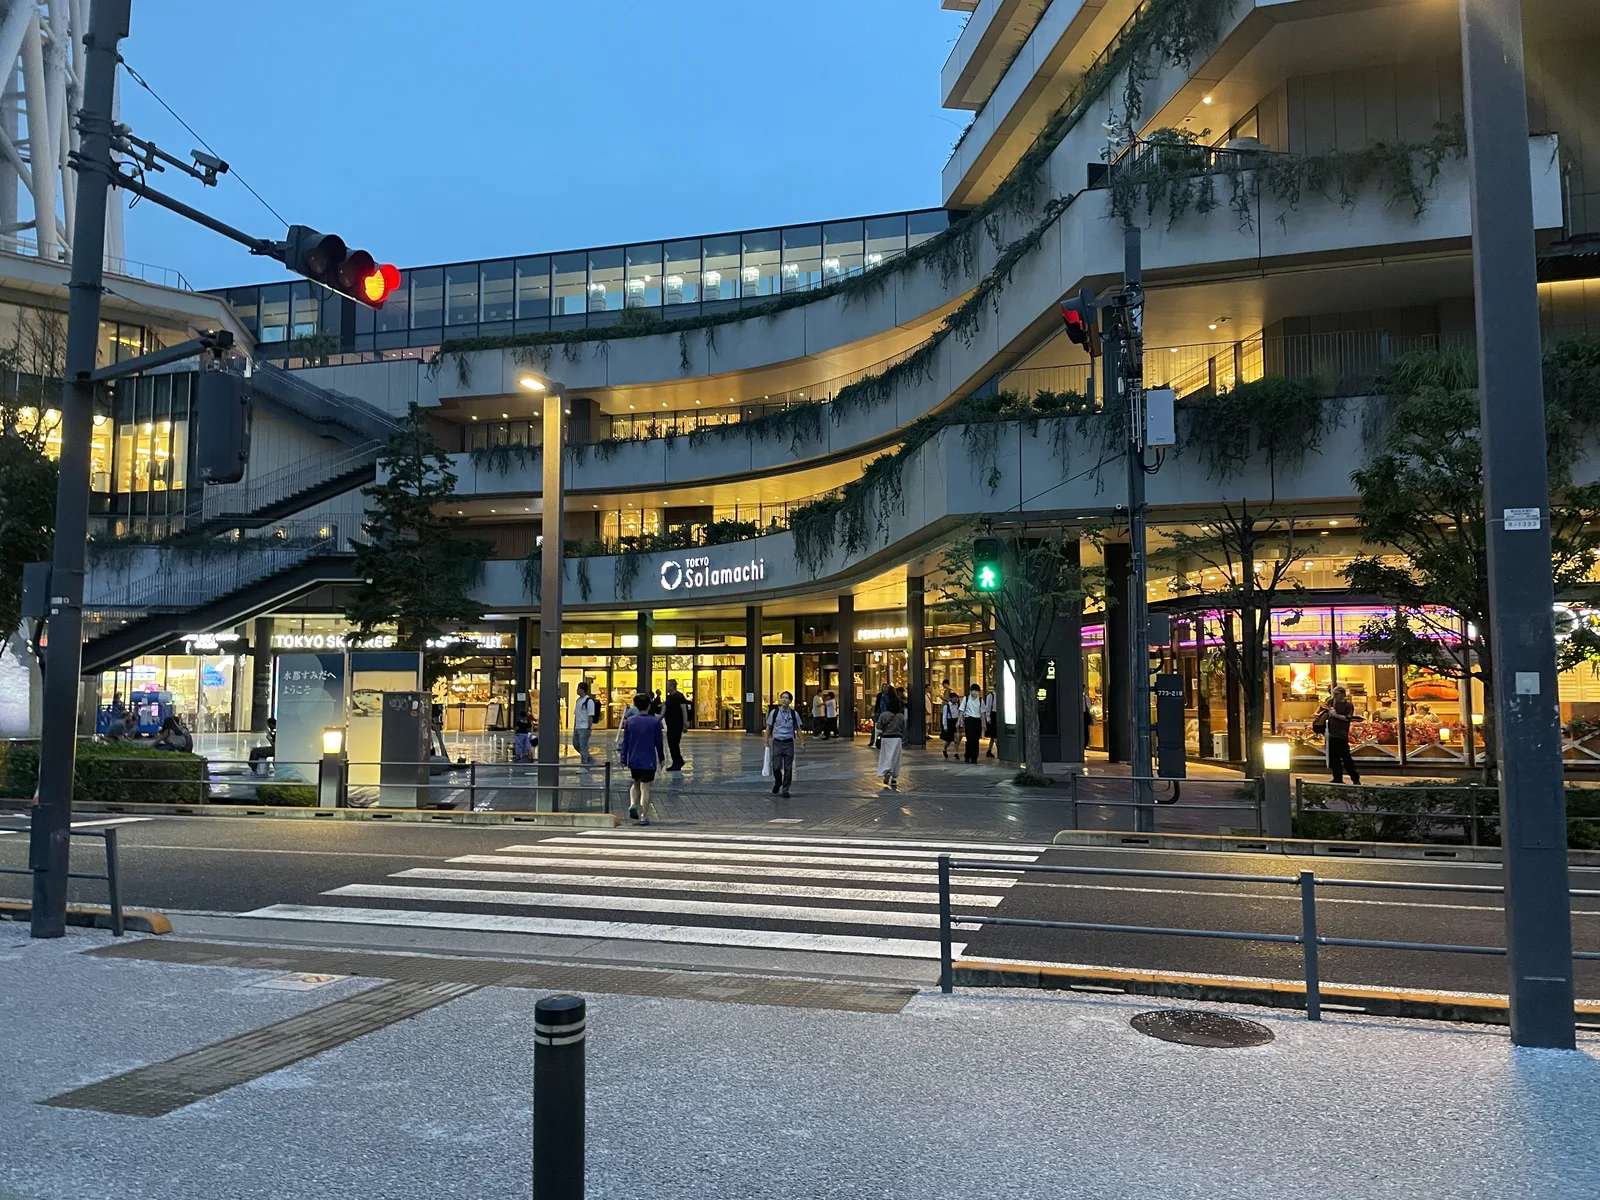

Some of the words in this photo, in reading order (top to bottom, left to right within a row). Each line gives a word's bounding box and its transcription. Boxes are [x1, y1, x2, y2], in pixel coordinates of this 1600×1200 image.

[685, 556, 709, 568] TOKYO
[685, 558, 764, 588] Solamachi
[276, 634, 323, 648] TOKYO
[283, 670, 337, 681] 水都すみだへ
[282, 684, 312, 695] ようこそ
